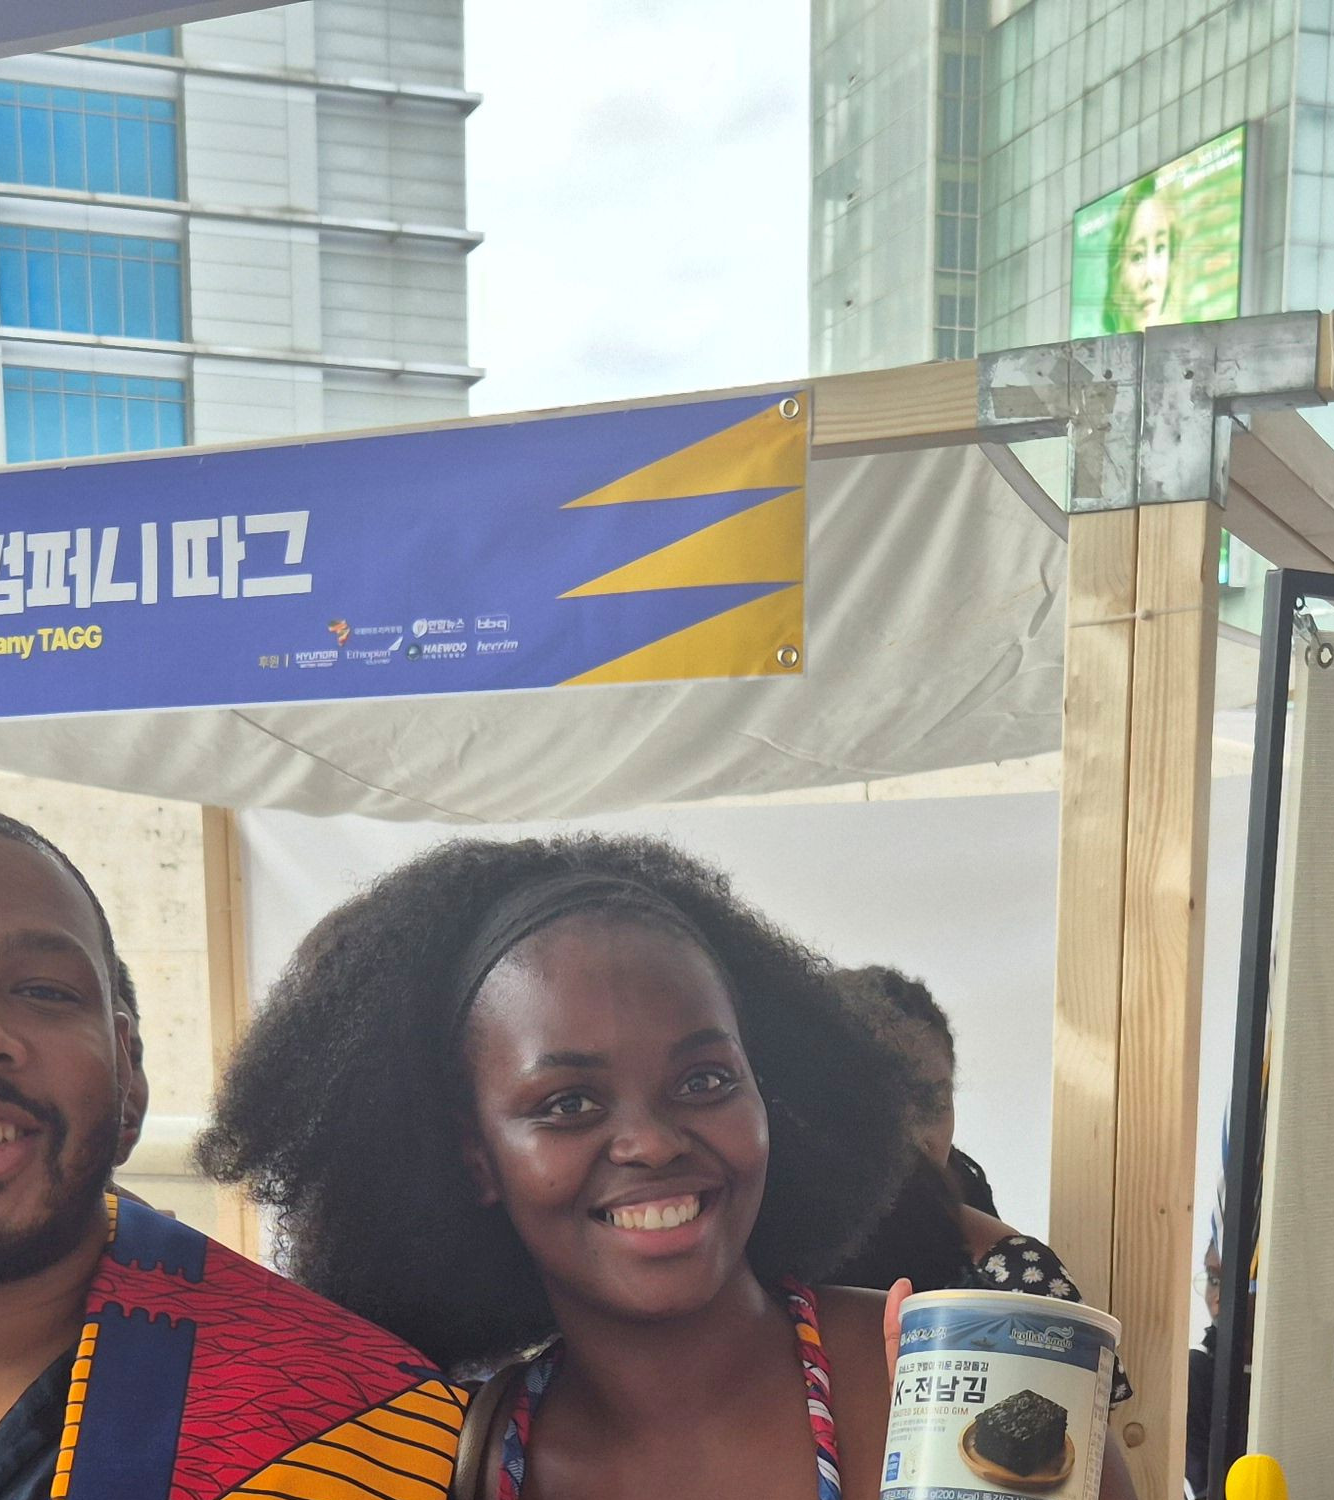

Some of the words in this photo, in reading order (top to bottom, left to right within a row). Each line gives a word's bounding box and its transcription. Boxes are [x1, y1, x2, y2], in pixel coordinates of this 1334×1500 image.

[171, 510, 314, 599] 따그
[37, 624, 103, 653] TAGG
[295, 651, 339, 662] HYUNDAI
[894, 1375, 988, 1407] K-전남김
